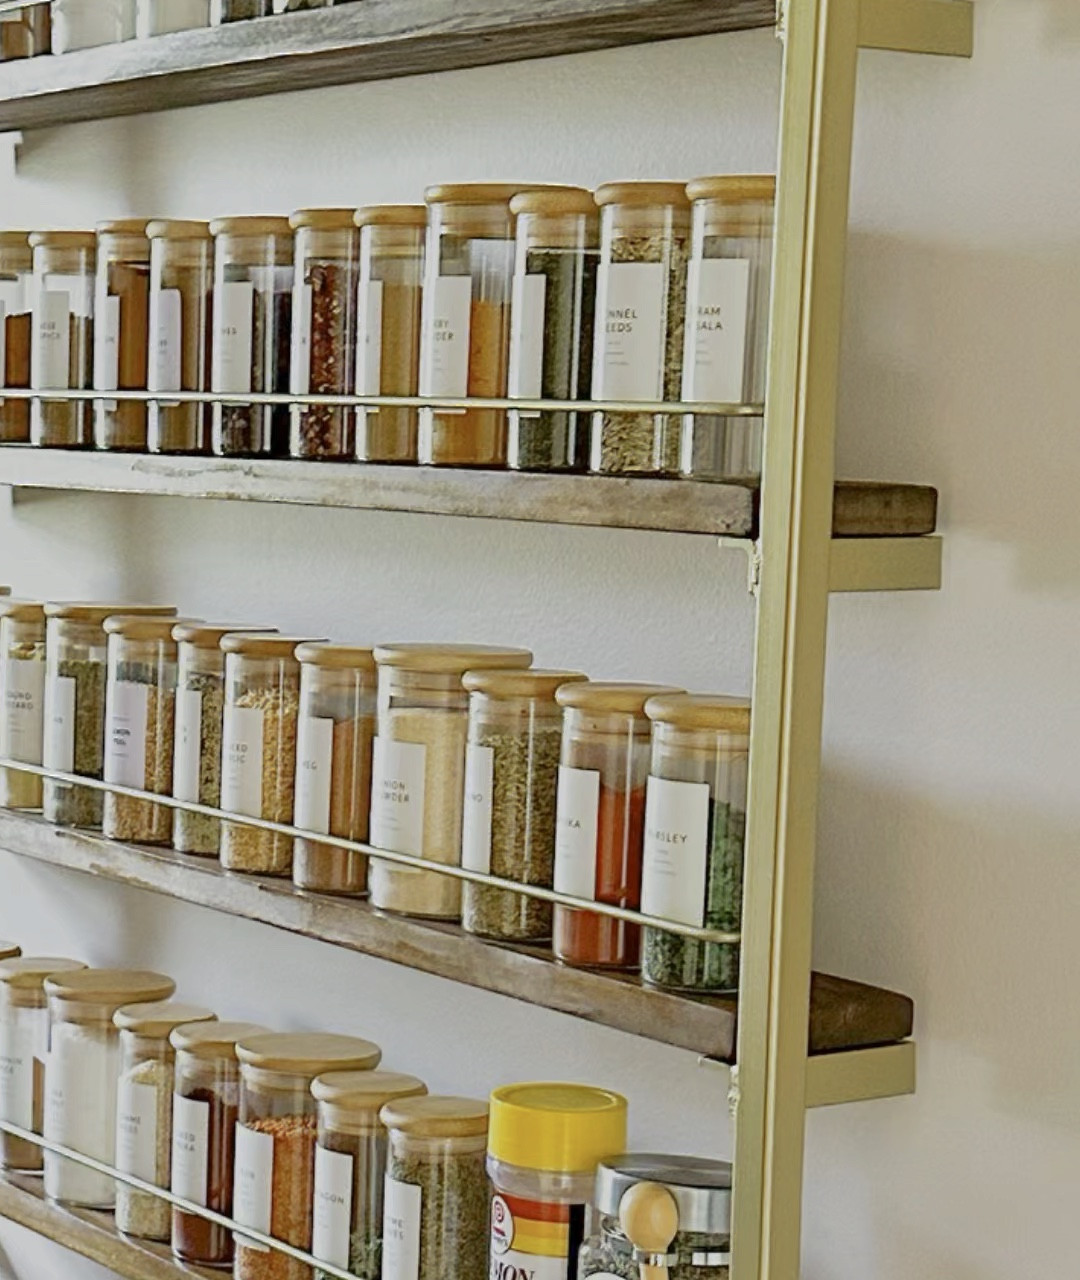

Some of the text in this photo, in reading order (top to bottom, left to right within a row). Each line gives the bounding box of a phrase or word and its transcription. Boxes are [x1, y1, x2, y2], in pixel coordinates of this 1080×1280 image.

[608, 308, 639, 320] NNEL
[605, 322, 634, 334] EEDS
[383, 780, 406, 791] NION
